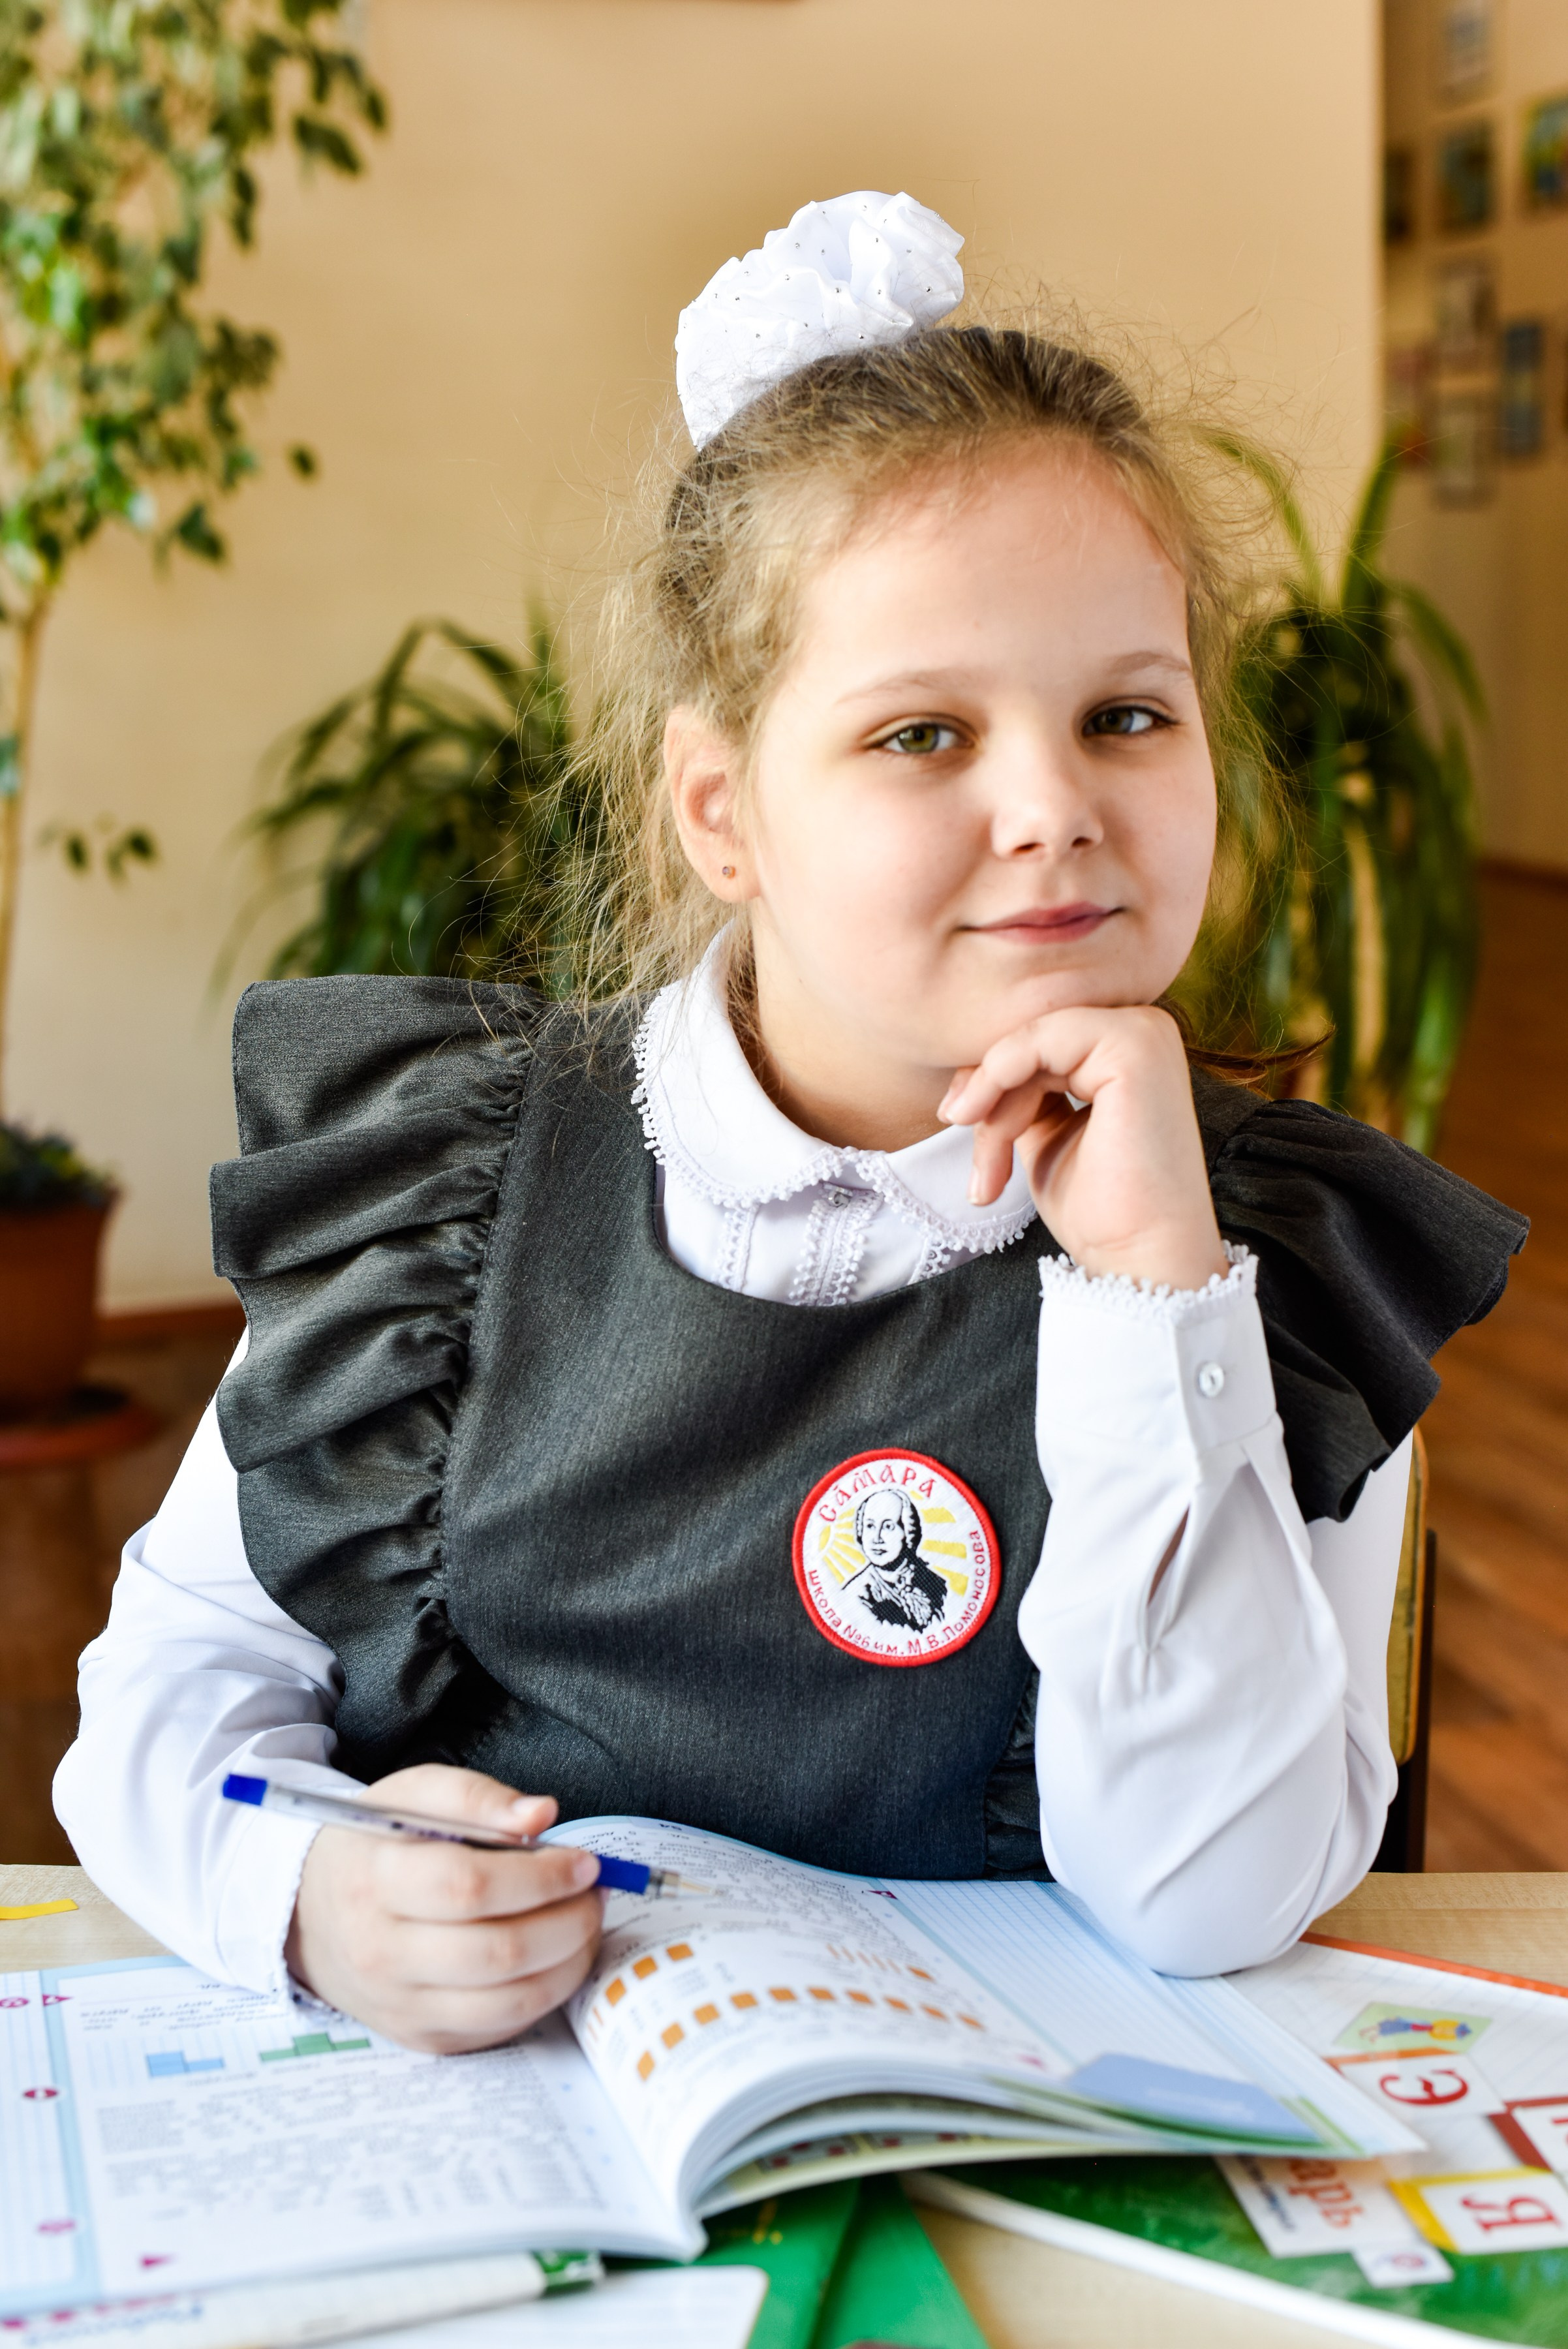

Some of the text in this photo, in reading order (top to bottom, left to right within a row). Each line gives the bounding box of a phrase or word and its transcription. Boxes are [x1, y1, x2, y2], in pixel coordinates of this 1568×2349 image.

[808, 1569, 842, 1627] школа
[874, 1642, 904, 1655] им.
[1379, 2068, 1468, 2106] Э
[1460, 2194, 1563, 2235] Я
